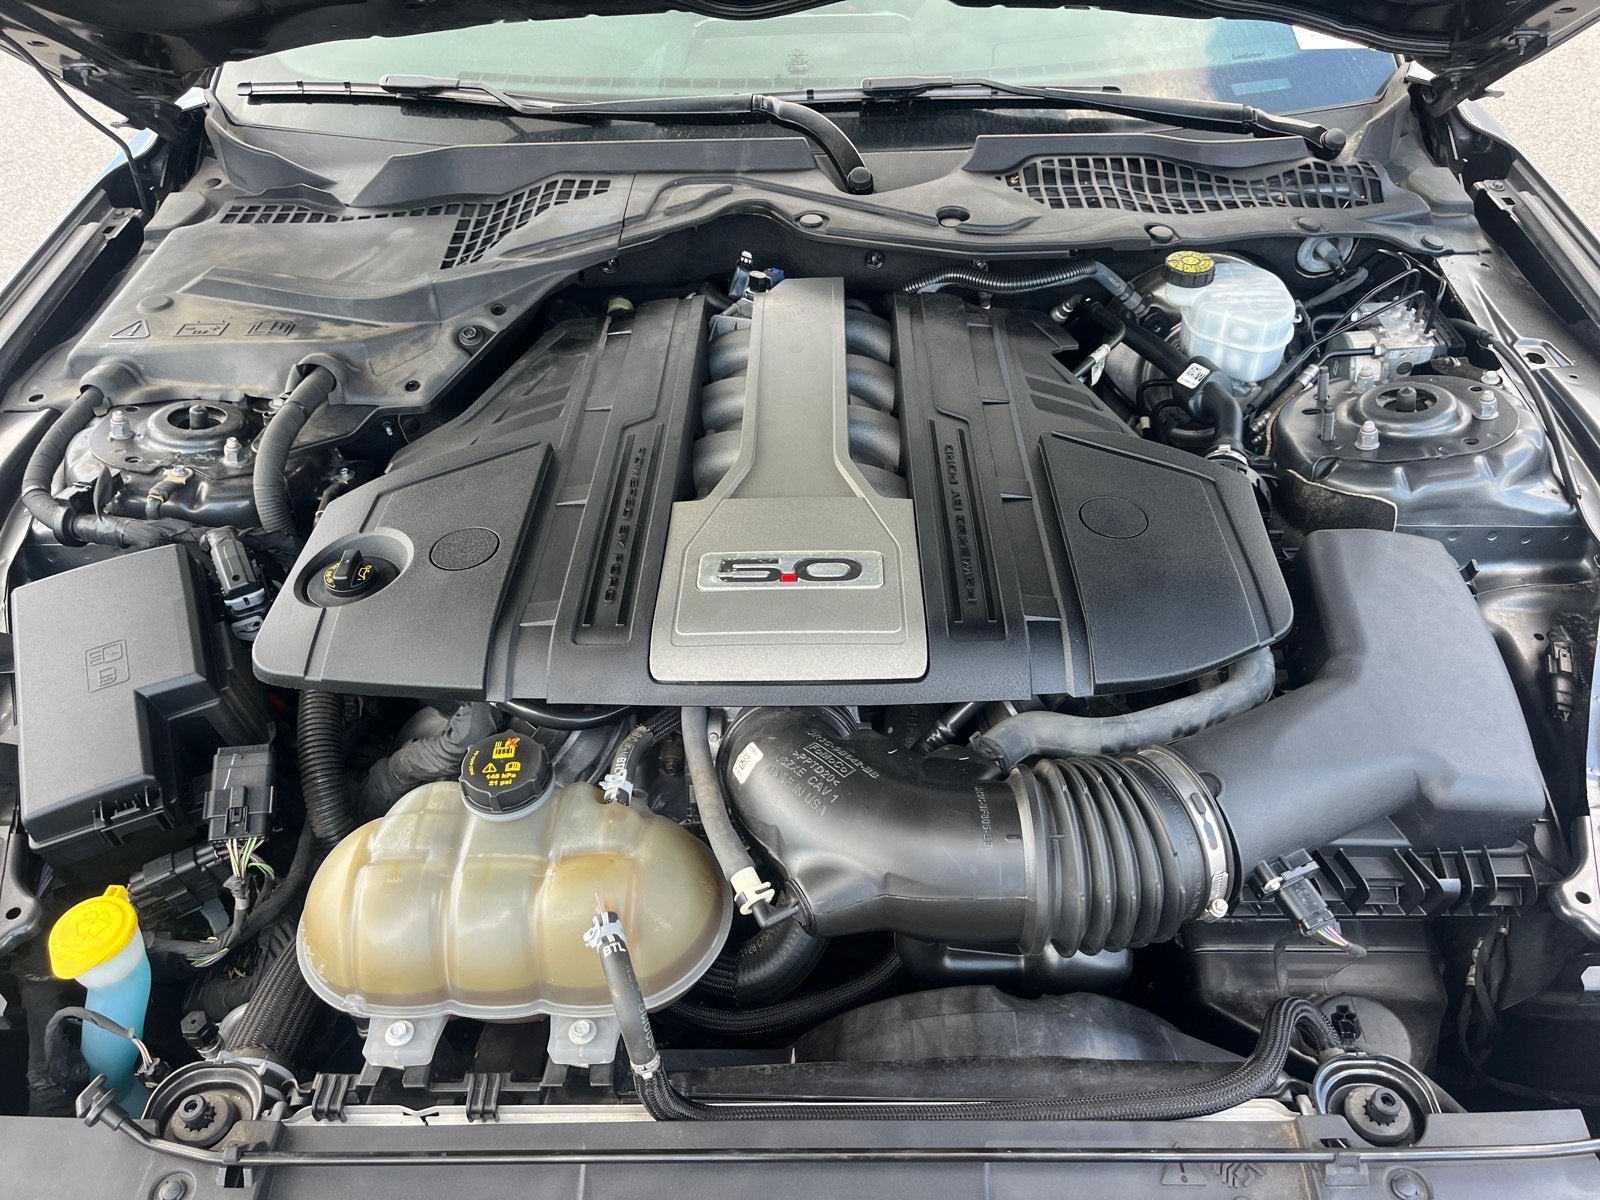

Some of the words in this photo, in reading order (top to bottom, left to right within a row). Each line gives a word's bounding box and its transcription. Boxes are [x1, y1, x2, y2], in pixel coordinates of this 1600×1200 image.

[716, 557, 863, 583] 5.0
[808, 744, 849, 773] FoMoCo
[807, 775, 832, 796] CAV
[792, 783, 806, 797] IN
[804, 793, 827, 816] USA
[602, 941, 627, 958] BTL
